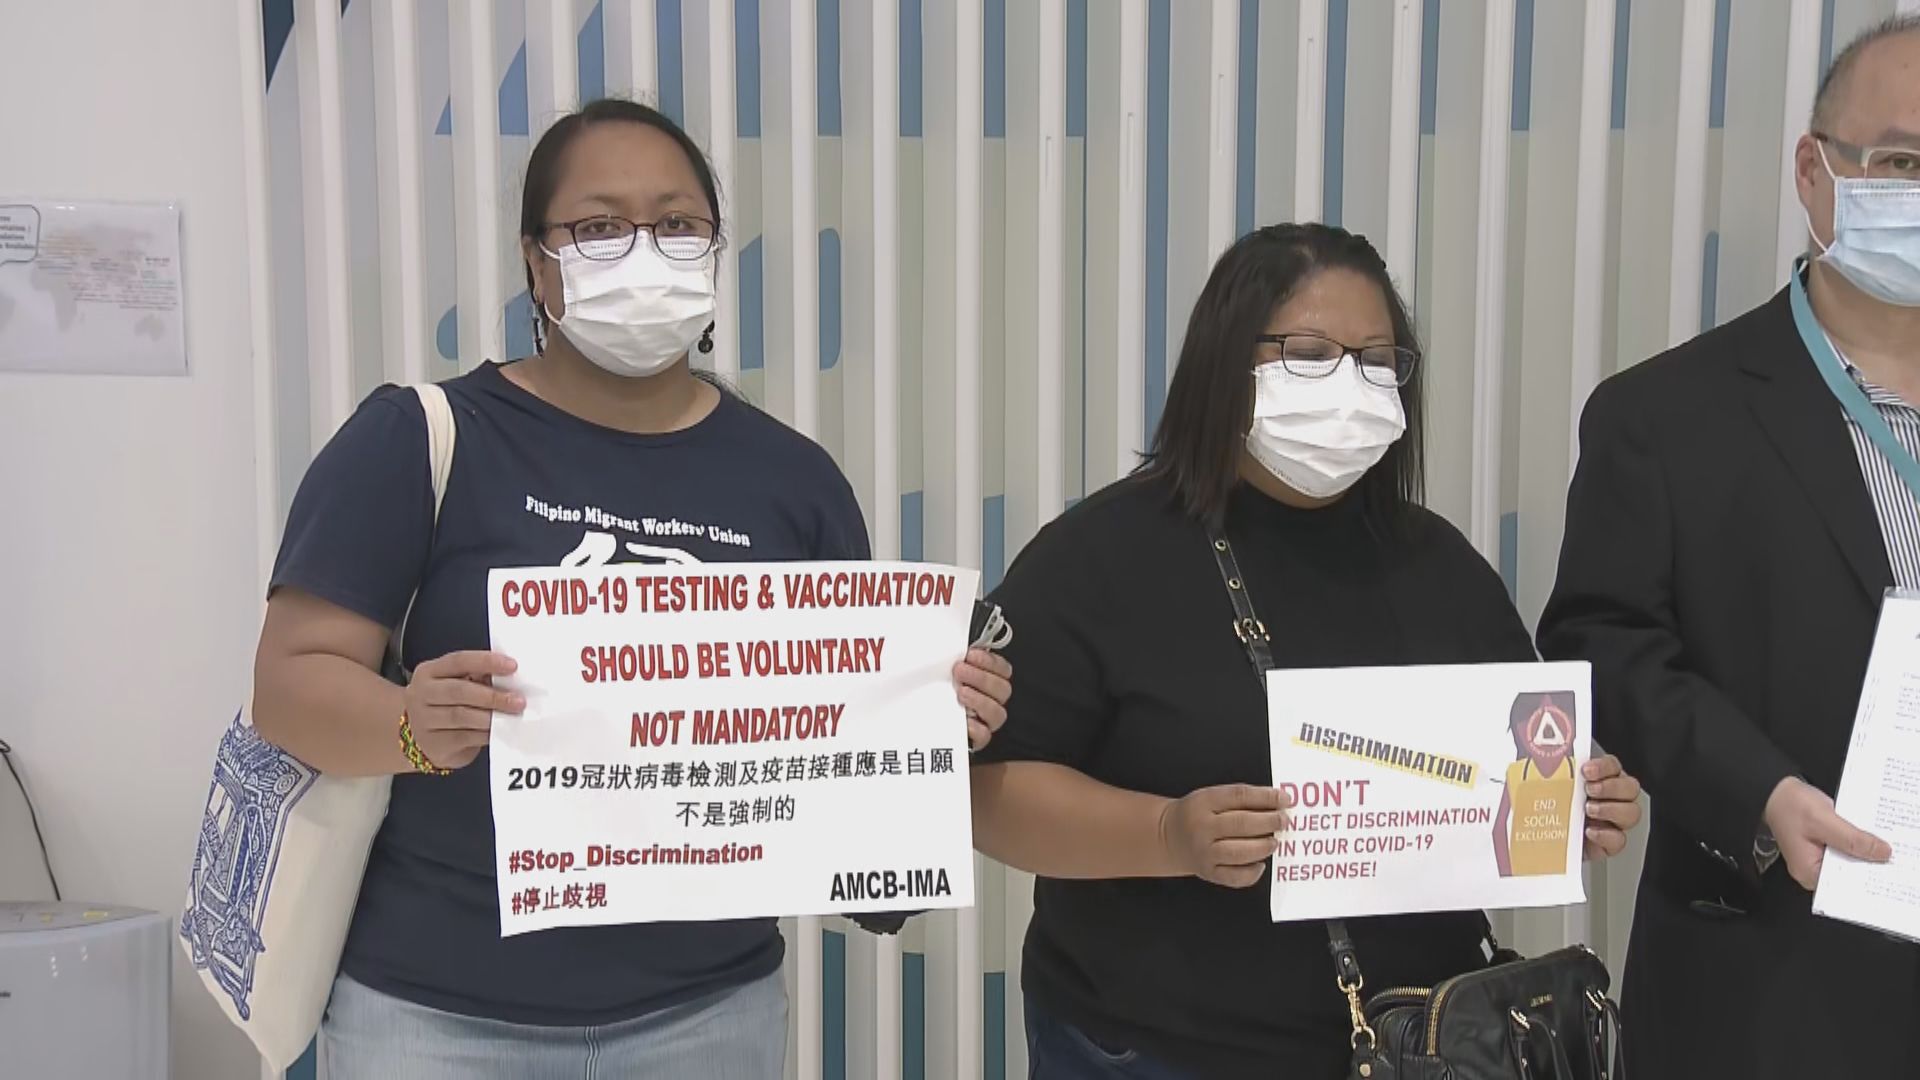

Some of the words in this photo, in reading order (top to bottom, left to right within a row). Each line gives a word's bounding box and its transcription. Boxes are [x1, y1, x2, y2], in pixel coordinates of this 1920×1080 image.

[525, 494, 581, 522] Filipino
[584, 505, 640, 533] Migrant
[708, 525, 751, 548] Union
[502, 577, 627, 617] COVID-19
[636, 574, 748, 612] TESTING
[757, 574, 774, 609] &
[784, 572, 955, 609] VACCINATION
[581, 644, 689, 683] SHOULD
[697, 642, 730, 678] BE
[738, 637, 885, 677] VOLUNTARY
[630, 710, 685, 748] NOT
[692, 703, 845, 745] MANDATORY
[507, 747, 954, 791] 2019冠狀病毒檢測及疫苗接種應是自願
[1300, 722, 1473, 784] DISCRIMINATION
[675, 794, 795, 828] 不是強制的
[1280, 780, 1370, 808] DON'T
[1534, 799, 1556, 810] END
[1286, 812, 1342, 832] NJECT
[1347, 807, 1491, 830] DISCRIMINATION
[1523, 814, 1560, 827] SOCIAL
[508, 842, 763, 875] #Stop_Discrimination
[1278, 840, 1296, 857] IN
[1302, 838, 1348, 856] YOUR
[1354, 834, 1434, 853] COVID-19
[830, 868, 952, 902] AMCB-IMA
[1277, 861, 1377, 882] RESPONSE!
[511, 882, 608, 916] #停止歧視
